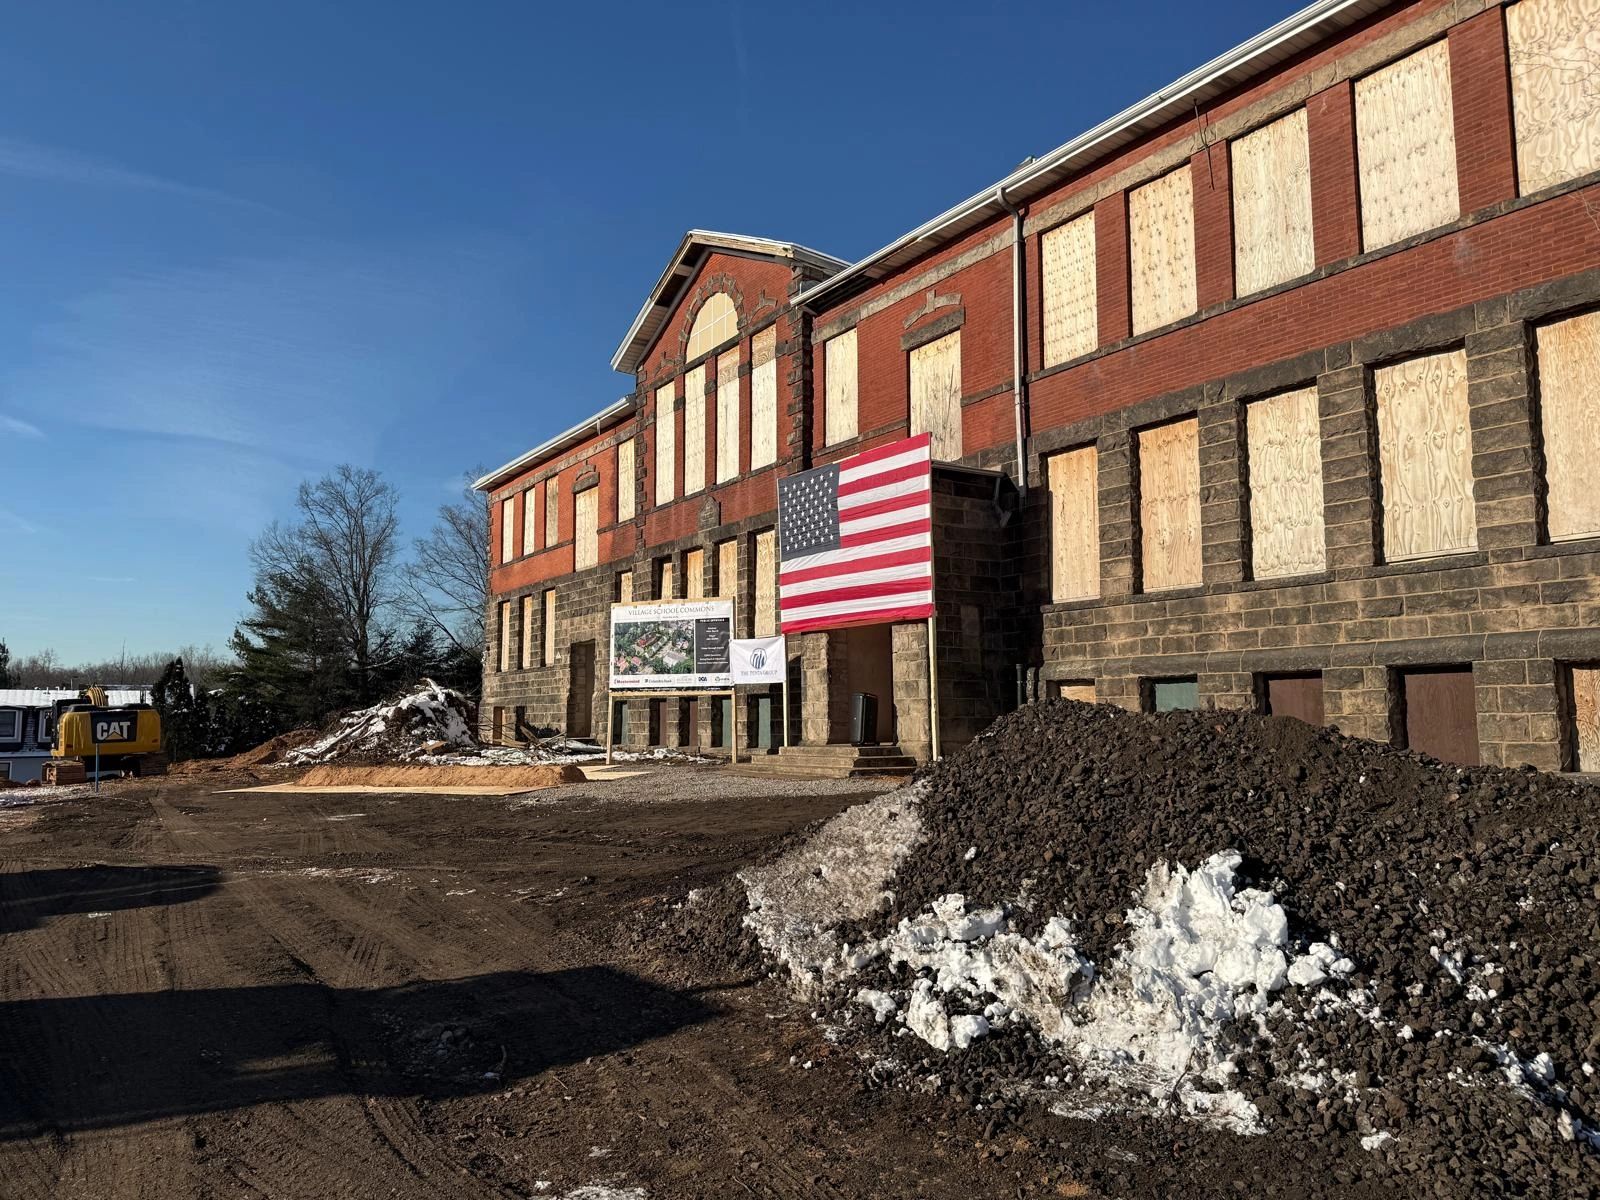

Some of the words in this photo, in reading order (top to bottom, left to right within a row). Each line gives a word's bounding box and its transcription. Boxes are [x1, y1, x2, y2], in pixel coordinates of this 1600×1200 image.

[653, 607, 679, 615] SCHOOL
[680, 606, 714, 614] COMMONS
[96, 721, 131, 741] CAT
